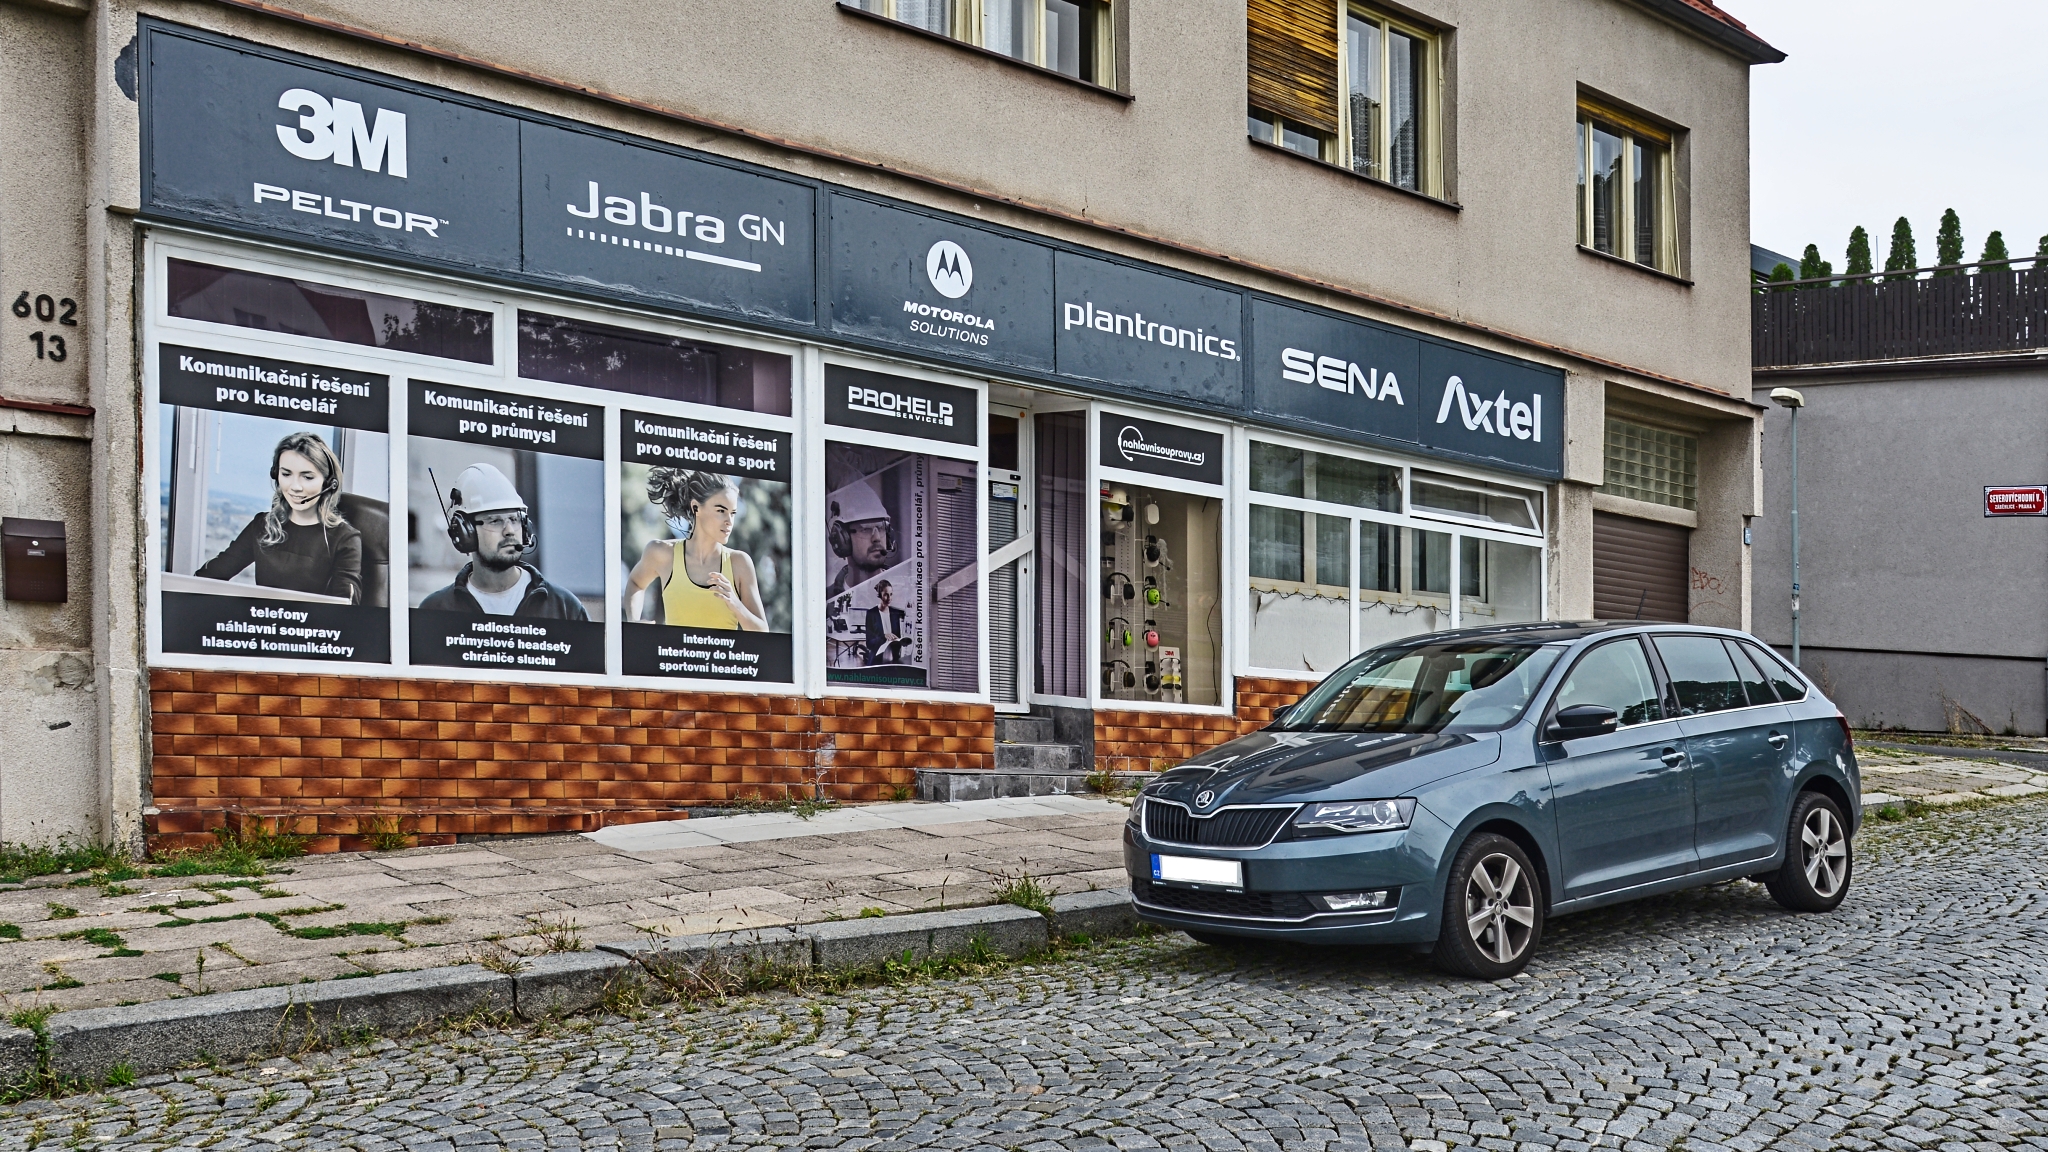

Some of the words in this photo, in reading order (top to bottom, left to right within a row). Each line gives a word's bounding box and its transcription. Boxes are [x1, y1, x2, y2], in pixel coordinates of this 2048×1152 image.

[276, 88, 408, 179] 3M
[566, 180, 725, 244] Jabra
[738, 213, 785, 246] GN
[12, 290, 78, 327] 602
[903, 300, 995, 331] MOTOROLA
[29, 330, 67, 363] 13
[909, 319, 989, 346] SOLUTIONS
[179, 355, 307, 389] Komunikační
[311, 373, 370, 398] řešení
[1281, 347, 1405, 406] SENA
[216, 386, 250, 402] pro
[254, 389, 338, 415] kancelář
[424, 389, 534, 420] Komunikační
[537, 405, 589, 428] řešení
[848, 385, 954, 419] PROHELP
[1436, 375, 1542, 443] Axtel
[459, 419, 488, 434] pro
[491, 422, 556, 444] průmysl
[896, 411, 944, 425] SERVICES
[634, 419, 730, 446] Komunikační
[733, 432, 778, 453] řešení
[1122, 438, 1202, 462] nahlavnisoupravy.cz
[636, 442, 662, 456] pro
[665, 446, 723, 464] outdoor
[725, 455, 735, 466] a
[738, 457, 776, 472] sport
[916, 540, 925, 558] pro
[915, 561, 923, 624] komunikace
[250, 606, 309, 623] telefony
[471, 621, 547, 636] radiostanice
[216, 619, 277, 635] náhlavní
[279, 625, 341, 641] soupravy
[445, 633, 515, 649] průmyslové
[517, 638, 572, 655] headsety
[683, 633, 736, 648] interkomy
[202, 635, 258, 650] hlasové
[260, 638, 355, 658] komunikátory
[462, 650, 515, 664] chrániče
[517, 653, 556, 666] sluchu
[658, 645, 711, 661] interkomy
[713, 649, 727, 660] do
[728, 650, 760, 664] helmy
[914, 627, 923, 663] Řešení
[659, 661, 710, 673] sportovní
[711, 663, 759, 677] headsety
[1153, 869, 1161, 877] CZ
